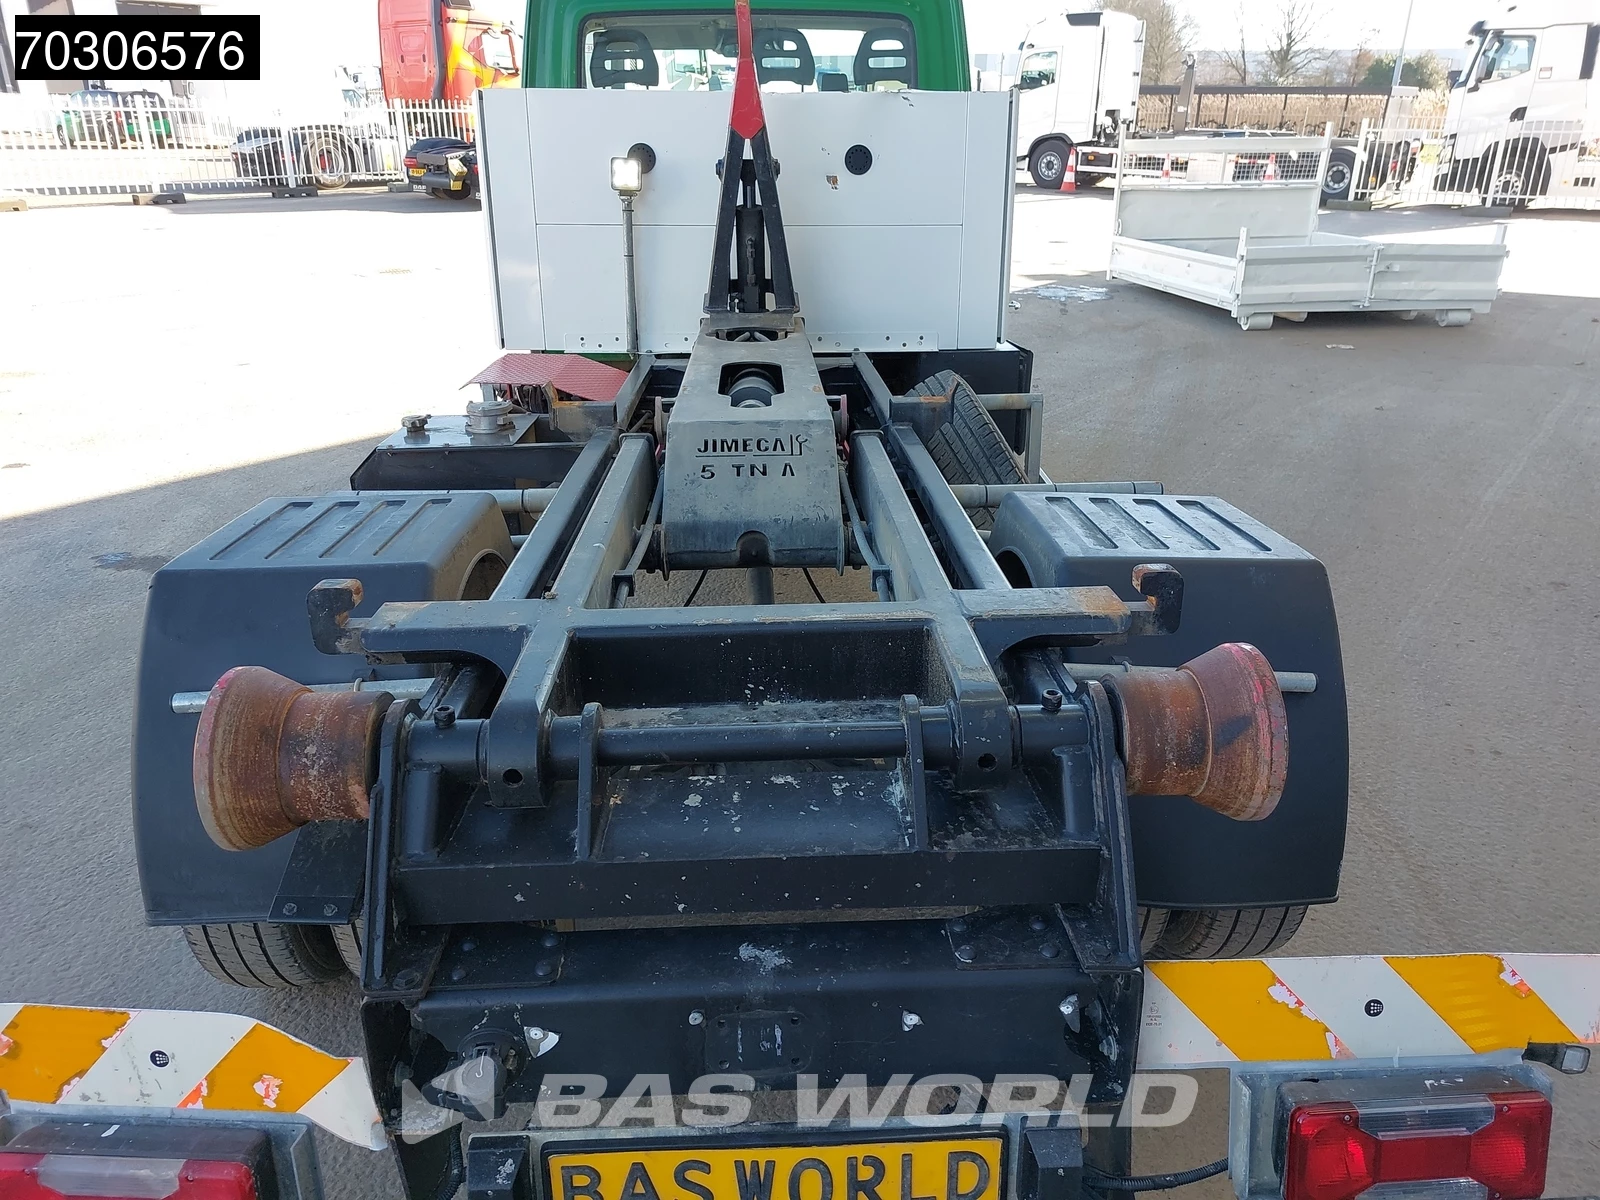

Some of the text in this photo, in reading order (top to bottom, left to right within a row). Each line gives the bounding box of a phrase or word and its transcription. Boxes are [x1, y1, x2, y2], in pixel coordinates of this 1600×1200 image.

[697, 437, 786, 453] JIMECA
[700, 464, 716, 480] 5
[731, 463, 768, 477] TN
[560, 1150, 991, 1200] BAS WORLD
